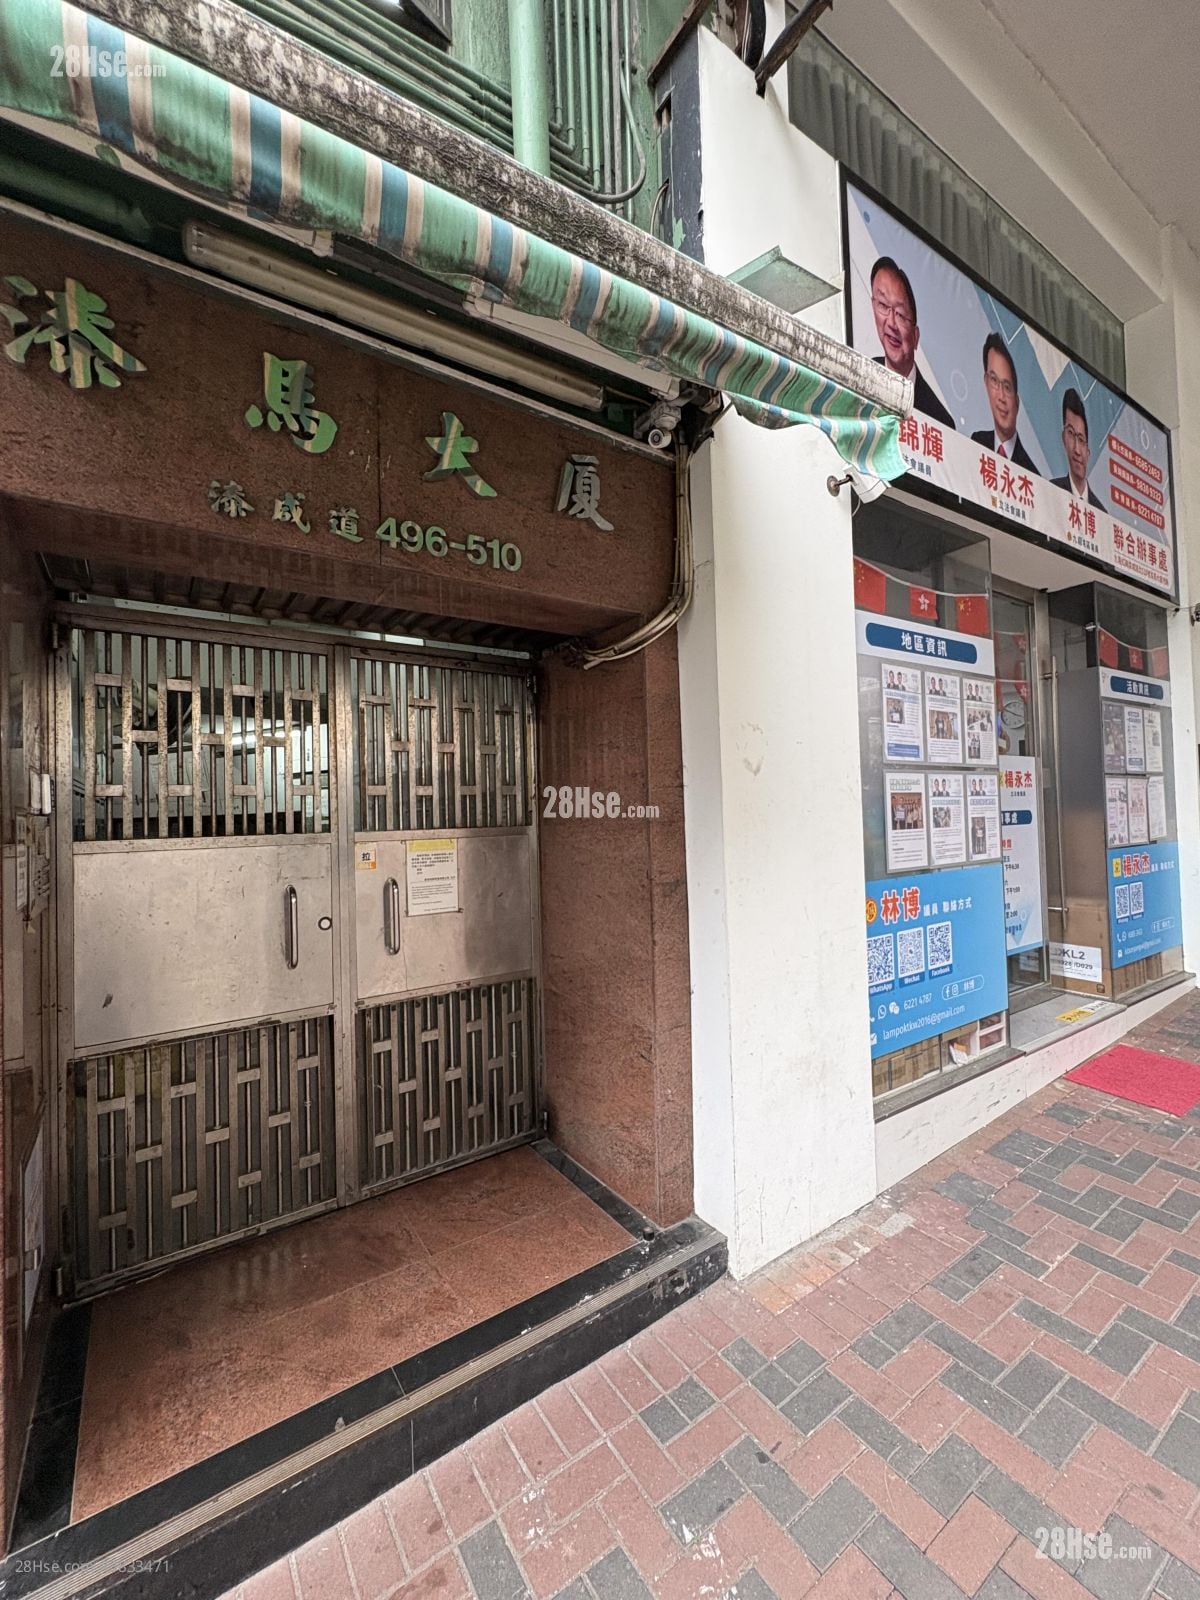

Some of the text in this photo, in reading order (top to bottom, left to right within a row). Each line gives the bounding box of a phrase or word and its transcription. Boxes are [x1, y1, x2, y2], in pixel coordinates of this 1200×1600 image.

[979, 453, 1035, 509] 楊永杰
[1068, 499, 1097, 539] 林博
[376, 517, 522, 572] 496-510
[901, 632, 948, 657] 地區資訊
[1004, 769, 1033, 789] 楊永杰
[1123, 853, 1150, 877] 楊永杰
[880, 887, 921, 925] 林博
